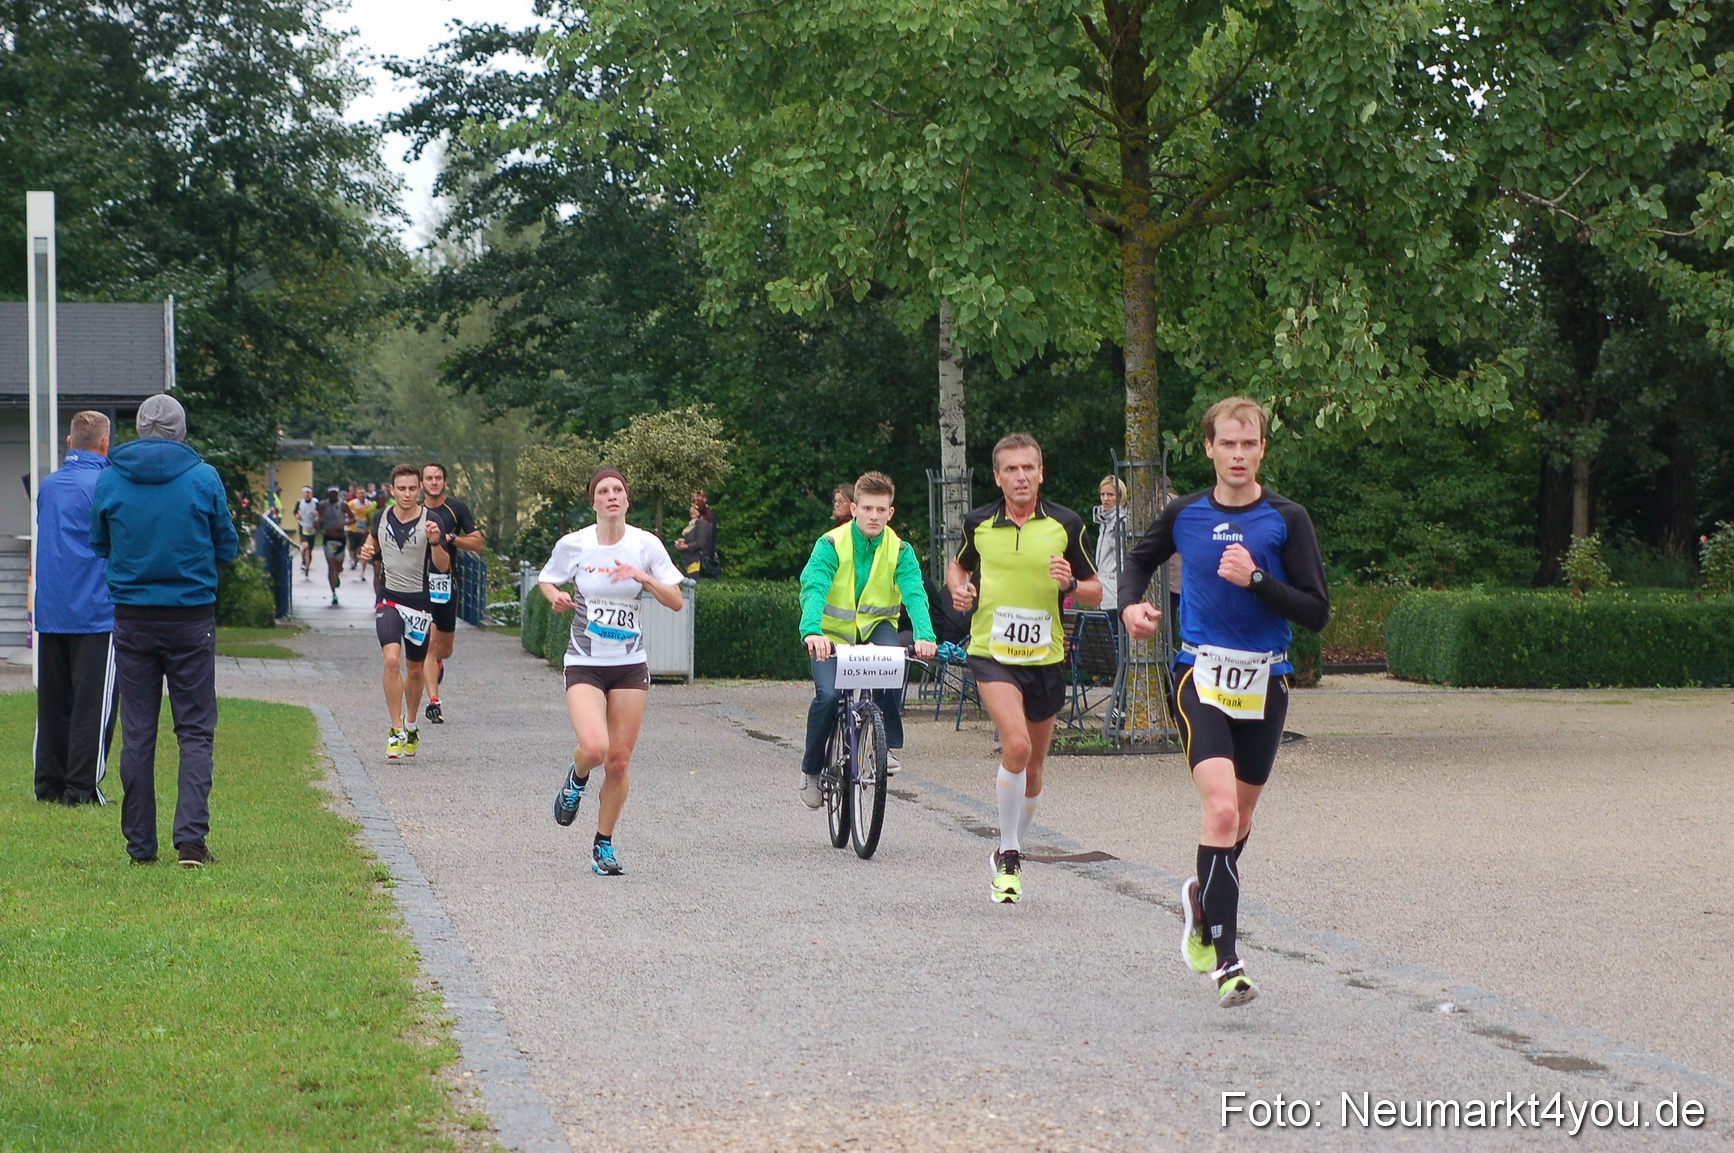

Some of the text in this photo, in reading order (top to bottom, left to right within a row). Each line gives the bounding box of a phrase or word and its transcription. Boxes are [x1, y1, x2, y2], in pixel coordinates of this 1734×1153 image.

[1212, 532, 1244, 542] skinfit
[594, 608, 635, 630] 2703
[599, 629, 626, 640] Jessica
[1003, 622, 1041, 644] 403
[848, 654, 892, 662] Erste Frau
[842, 668, 898, 677] 10,5 km Lauf
[1211, 664, 1258, 691] 107
[1217, 694, 1242, 708] Frank
